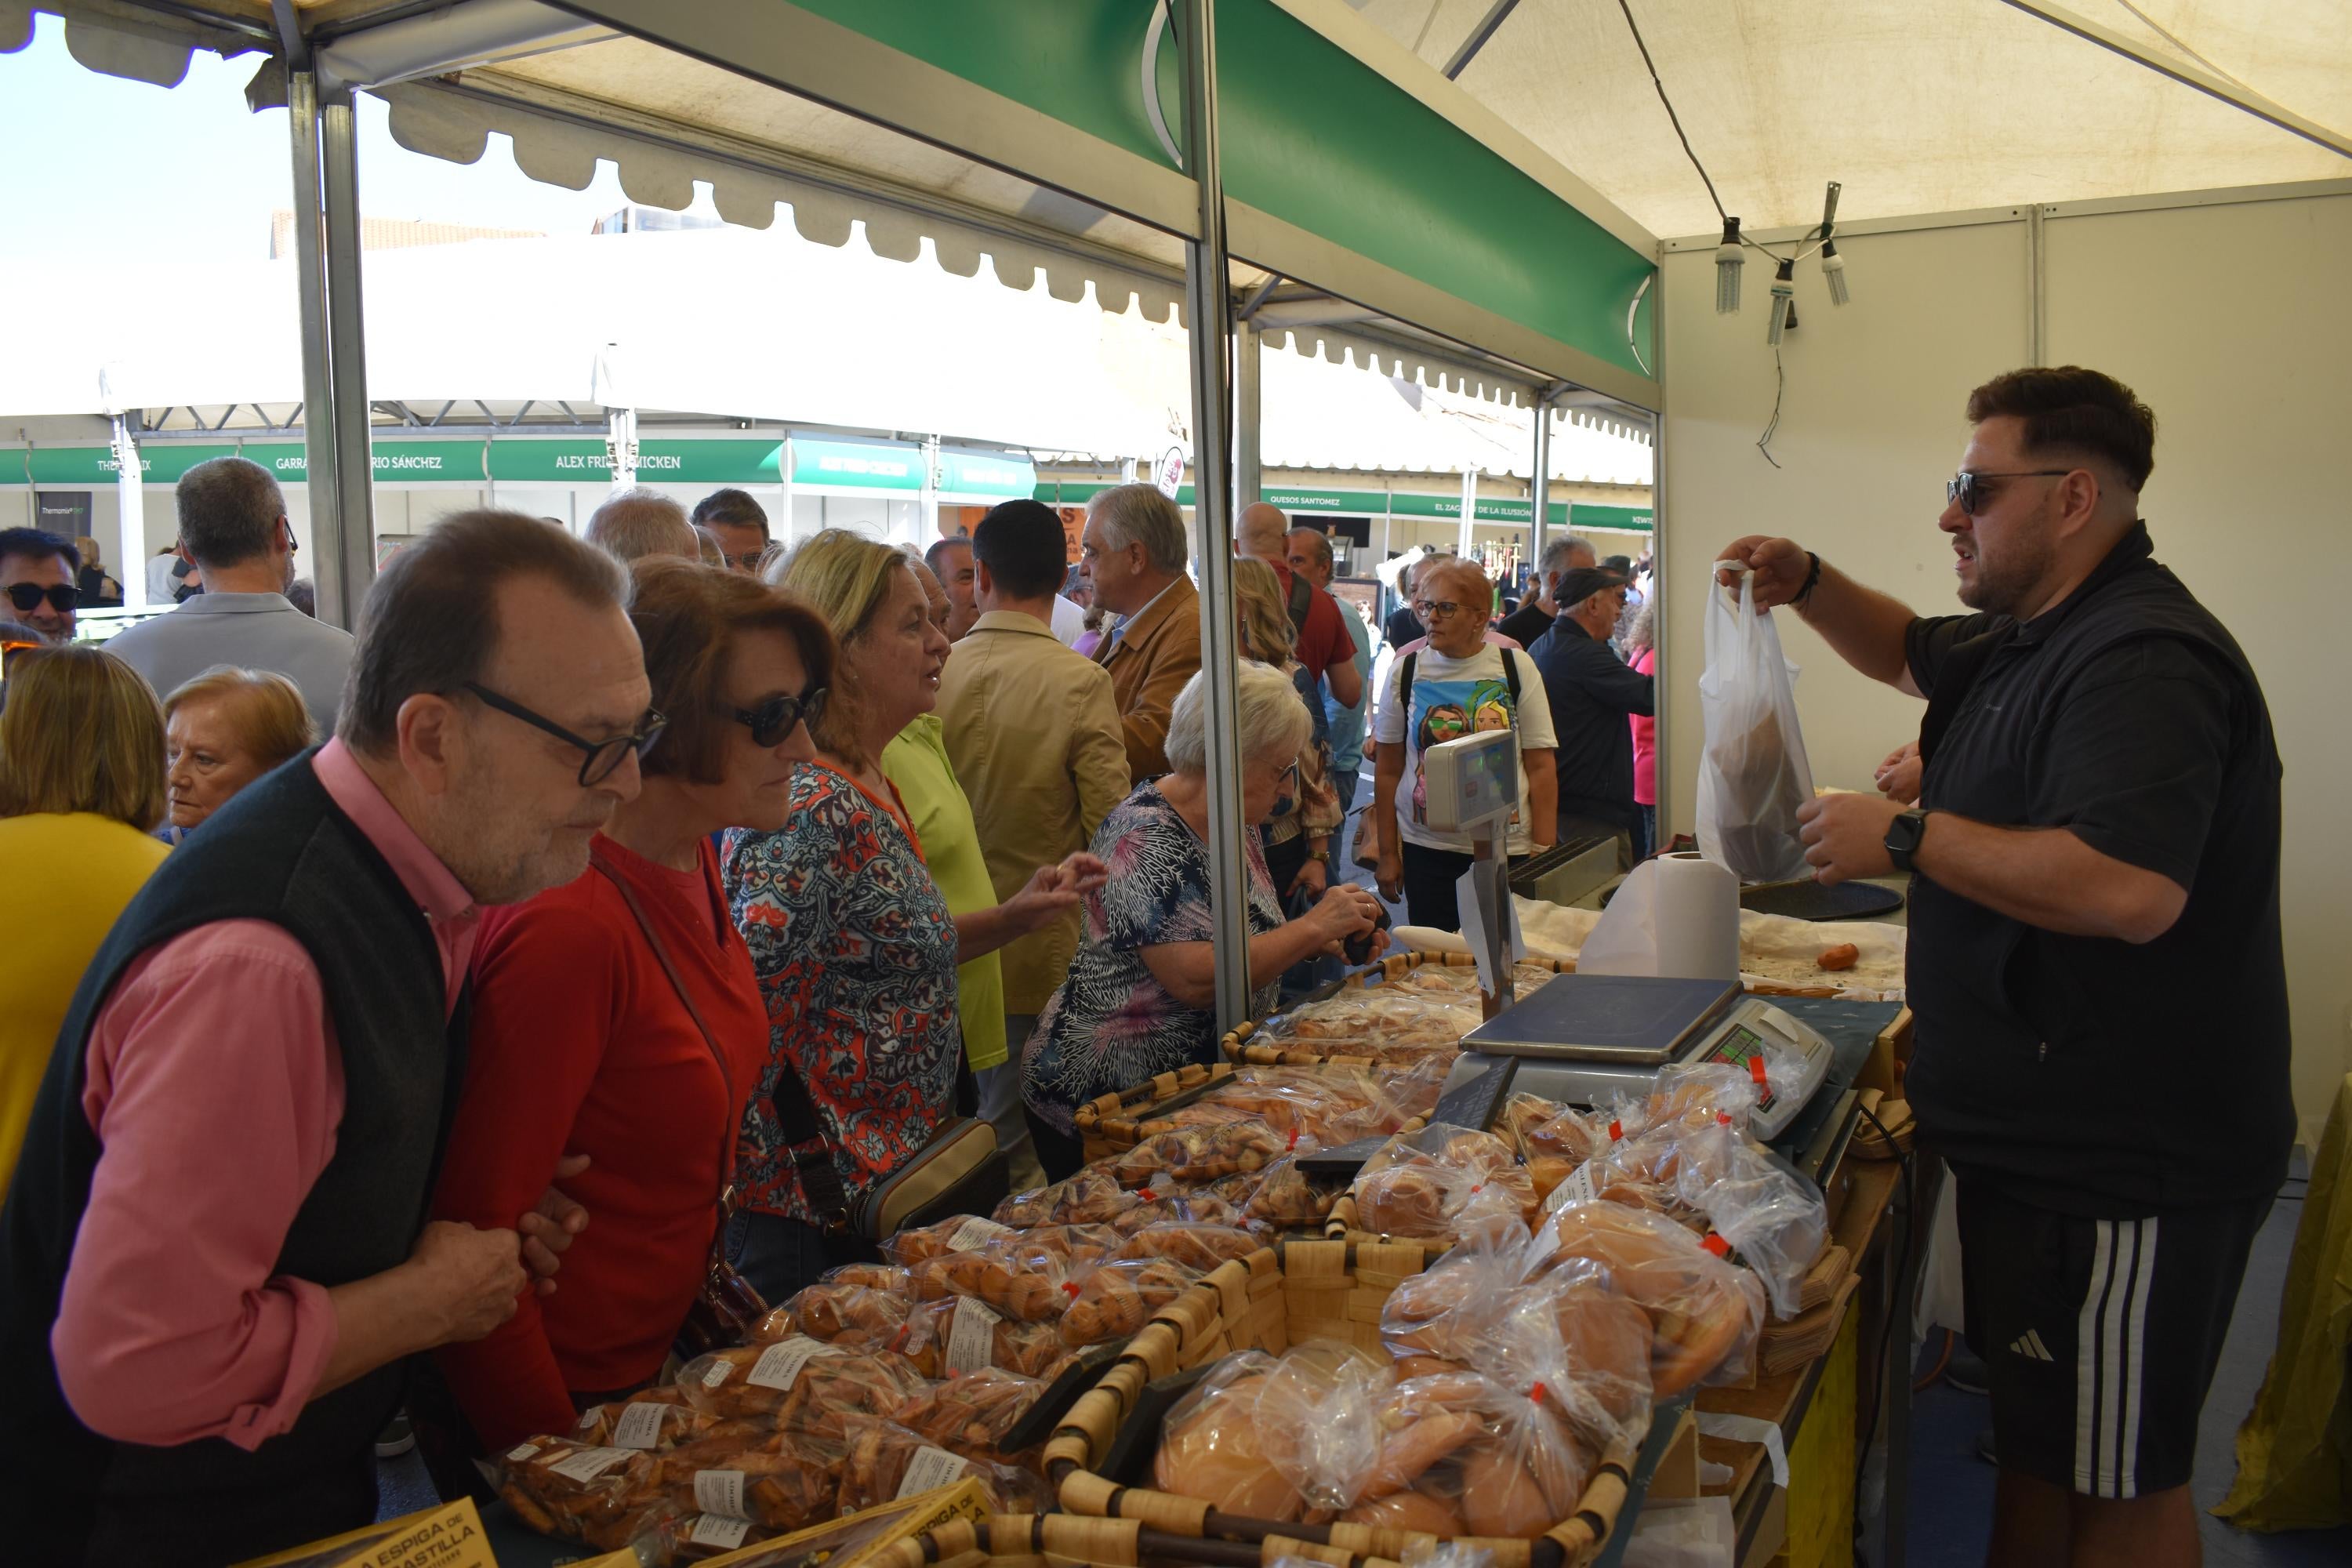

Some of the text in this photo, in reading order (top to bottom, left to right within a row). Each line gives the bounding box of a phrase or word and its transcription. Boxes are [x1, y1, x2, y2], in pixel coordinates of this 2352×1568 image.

[276, 455, 442, 470] GARRA RIO SÁNCHEZ
[556, 456, 585, 468] ALEX
[1270, 495, 1341, 506] QUESOS SANTOMEZ
[960, 1494, 975, 1509] DE
[377, 1523, 445, 1566] ESPIGA
[446, 1512, 463, 1528] DE
[395, 1526, 475, 1568] ASTILLA
